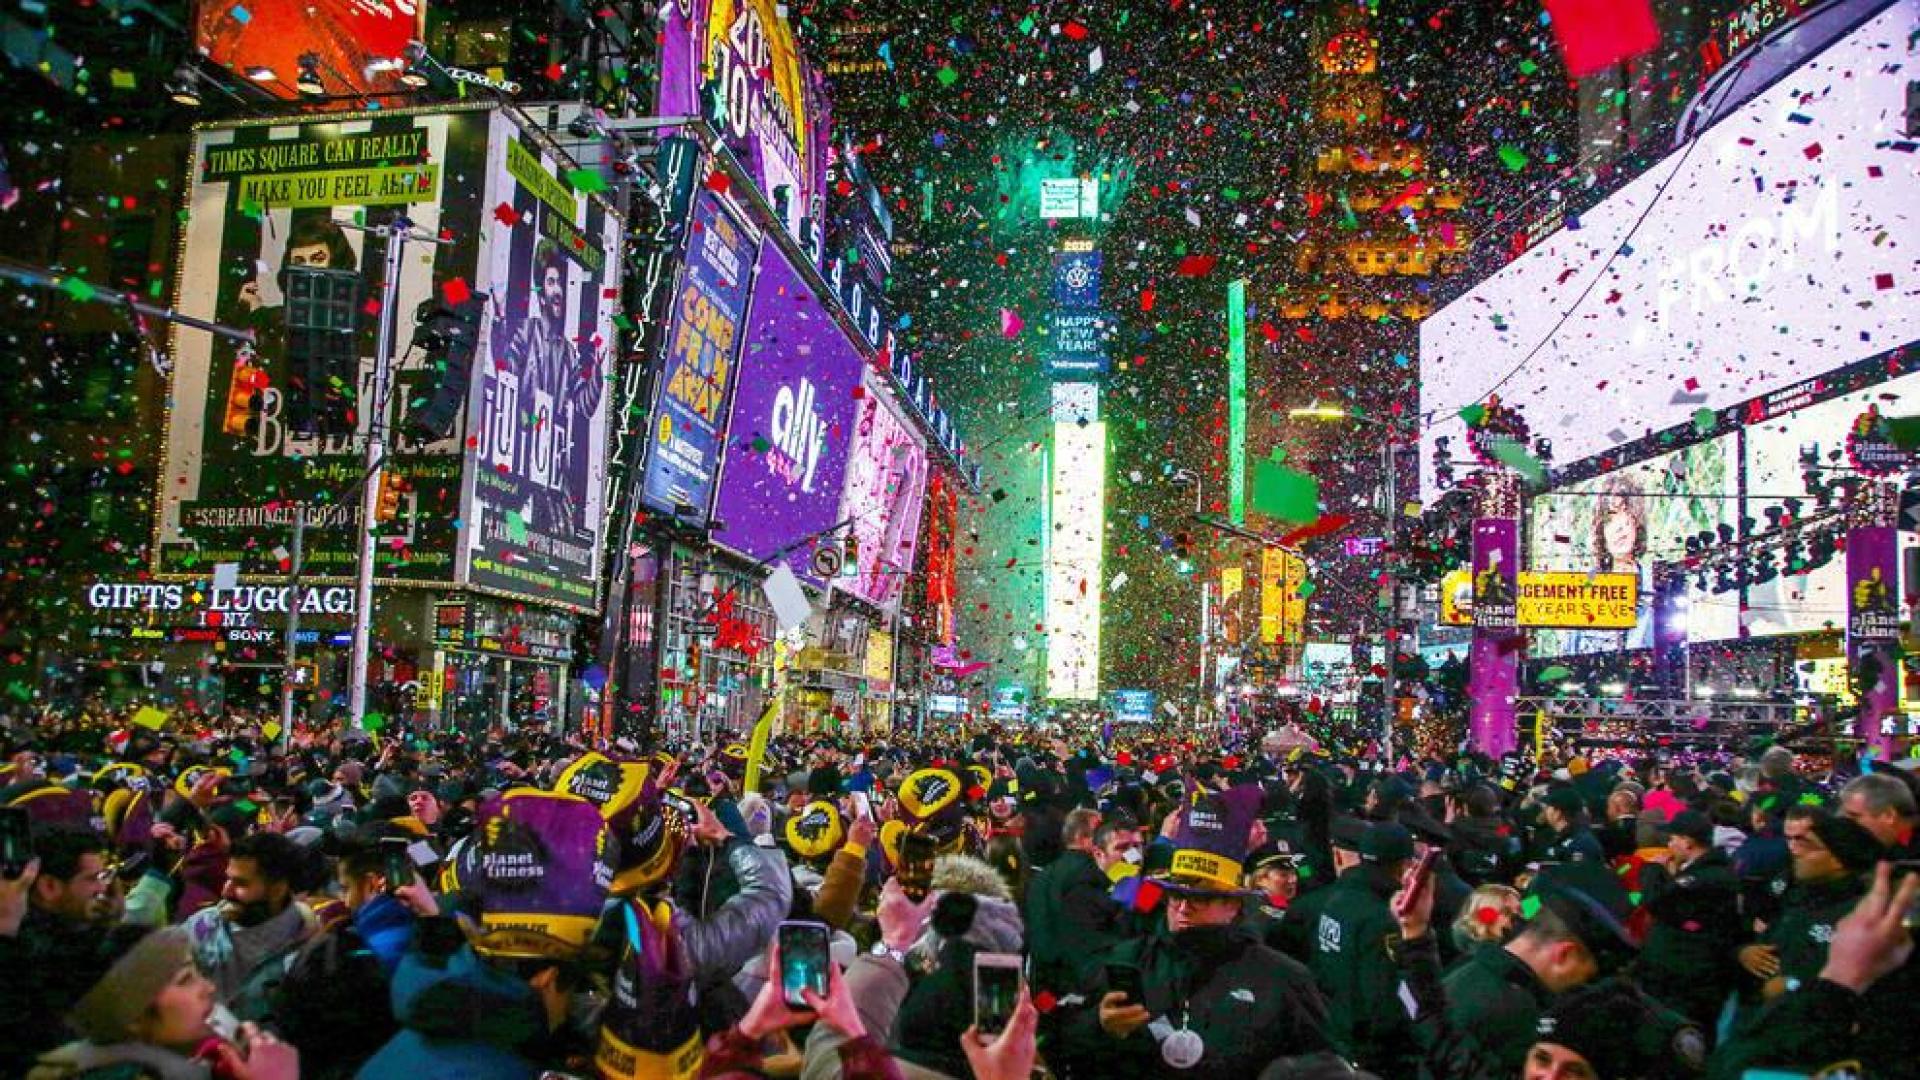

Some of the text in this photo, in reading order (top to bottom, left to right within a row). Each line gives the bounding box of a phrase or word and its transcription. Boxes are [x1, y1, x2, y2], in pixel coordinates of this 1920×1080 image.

[210, 132, 423, 173] TIMES SQUARE CAN REALLY
[247, 178, 291, 202] MAKE
[298, 176, 327, 200] YOU
[334, 174, 372, 199] FEEL
[1657, 172, 1838, 333] FROM
[772, 377, 838, 492] ally
[90, 583, 354, 615] GIFTS LUGAG
[1591, 584, 1628, 601] FREE
[1596, 603, 1629, 617] EVE
[222, 611, 249, 627] NY
[229, 629, 274, 641] SONY
[483, 852, 534, 868] planet
[488, 865, 545, 878] fitness
